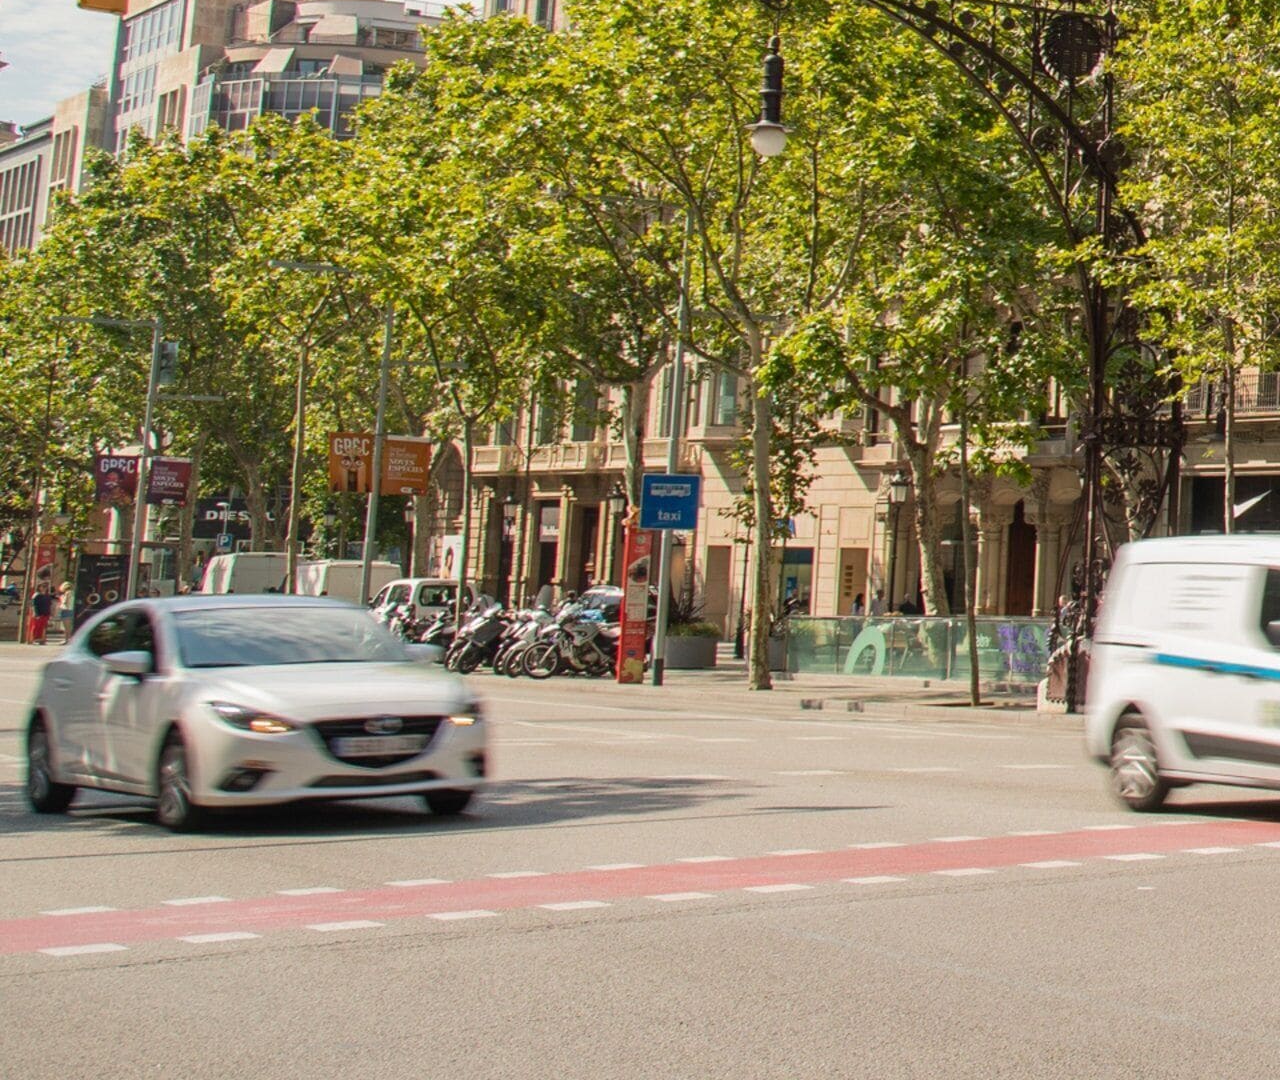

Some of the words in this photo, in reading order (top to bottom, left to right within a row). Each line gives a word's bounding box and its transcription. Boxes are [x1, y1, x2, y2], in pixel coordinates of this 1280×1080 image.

[206, 510, 276, 521] DIESL
[657, 510, 682, 521] taxi
[220, 536, 229, 546] P
